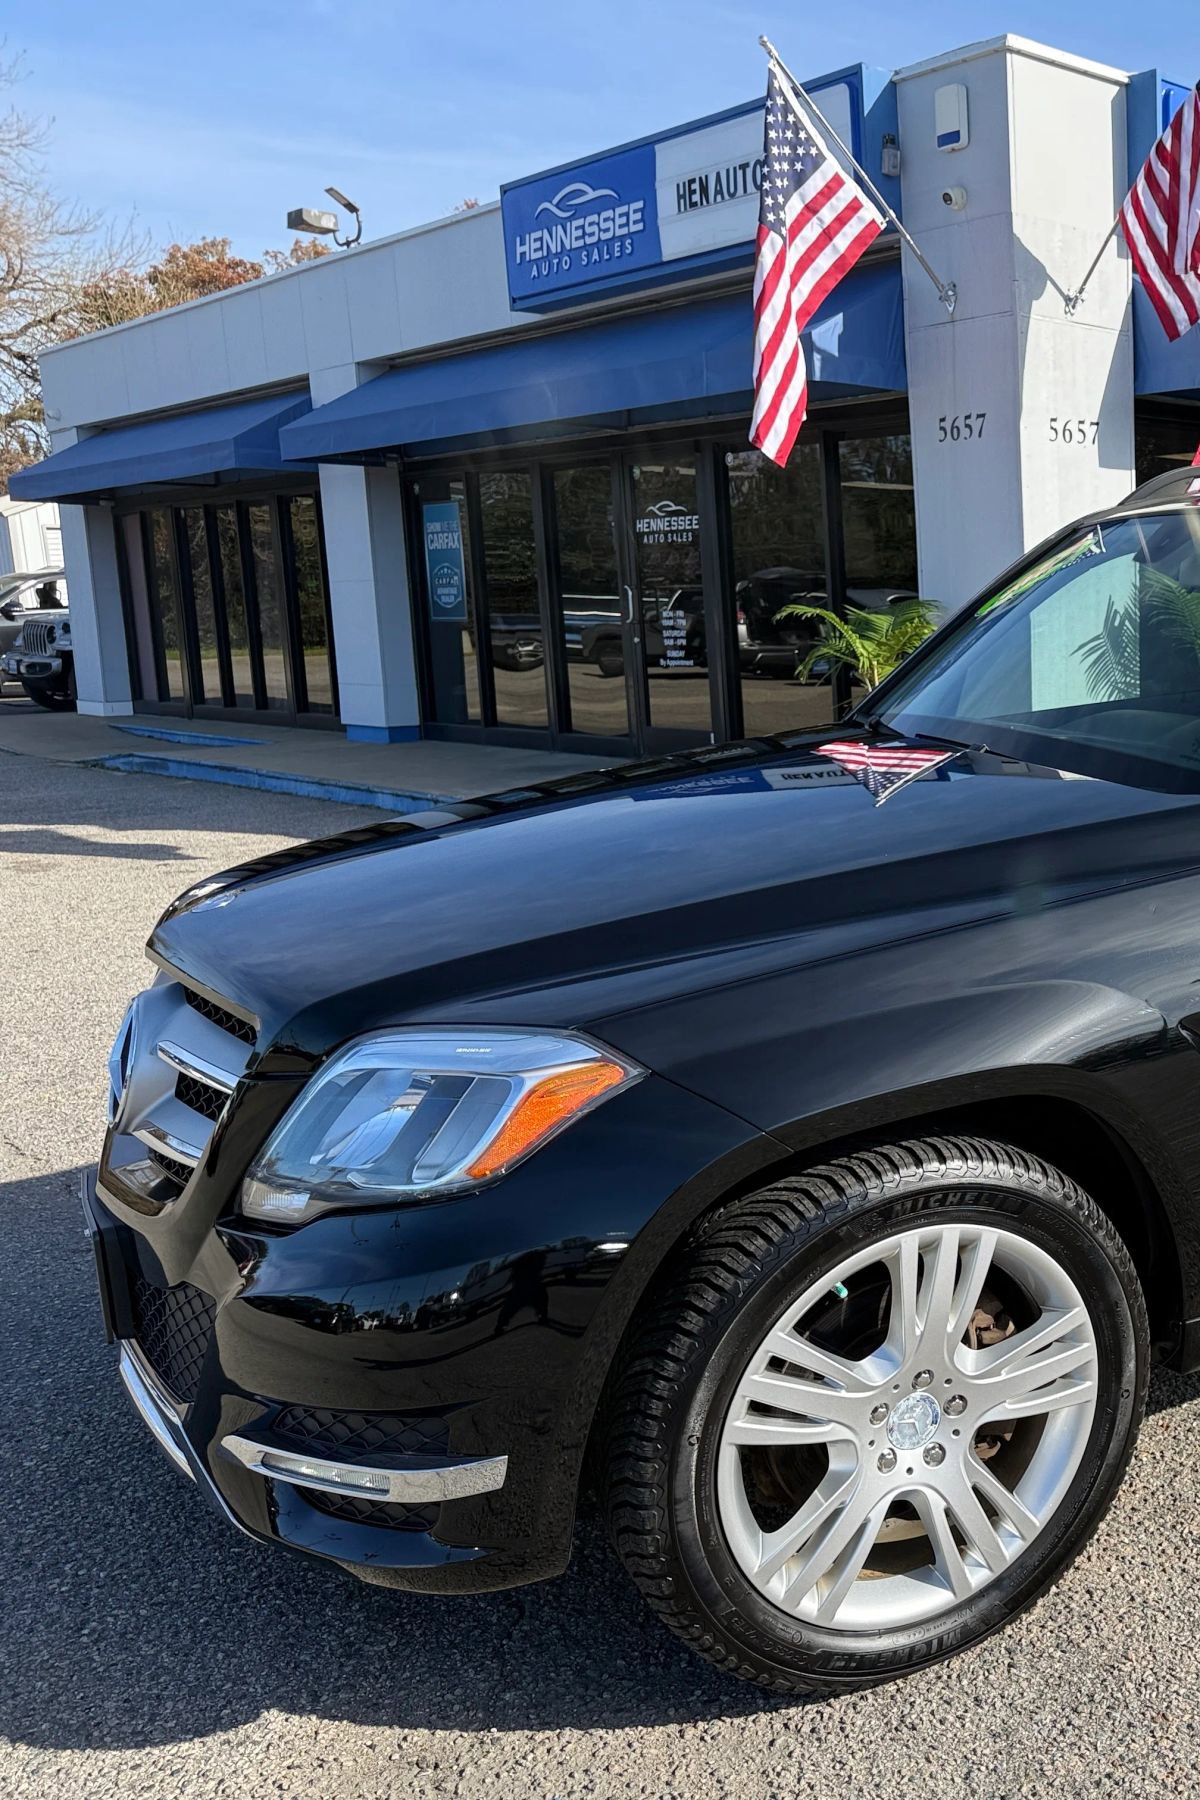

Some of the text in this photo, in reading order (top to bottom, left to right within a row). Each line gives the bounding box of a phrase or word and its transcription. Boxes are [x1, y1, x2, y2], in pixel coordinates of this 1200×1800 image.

[676, 158, 763, 213] HENAUTO
[516, 200, 644, 265] HENNESSEE
[530, 238, 633, 279] AUTO SALES
[938, 413, 987, 442] 5657
[1049, 417, 1100, 445] 5657
[636, 515, 699, 533] HENNESSEE
[643, 532, 693, 544] AUTO SALES
[427, 532, 460, 550] CARFAX
[662, 629, 687, 638] SATURDAY
[891, 1190, 1024, 1220] MICHELIN
